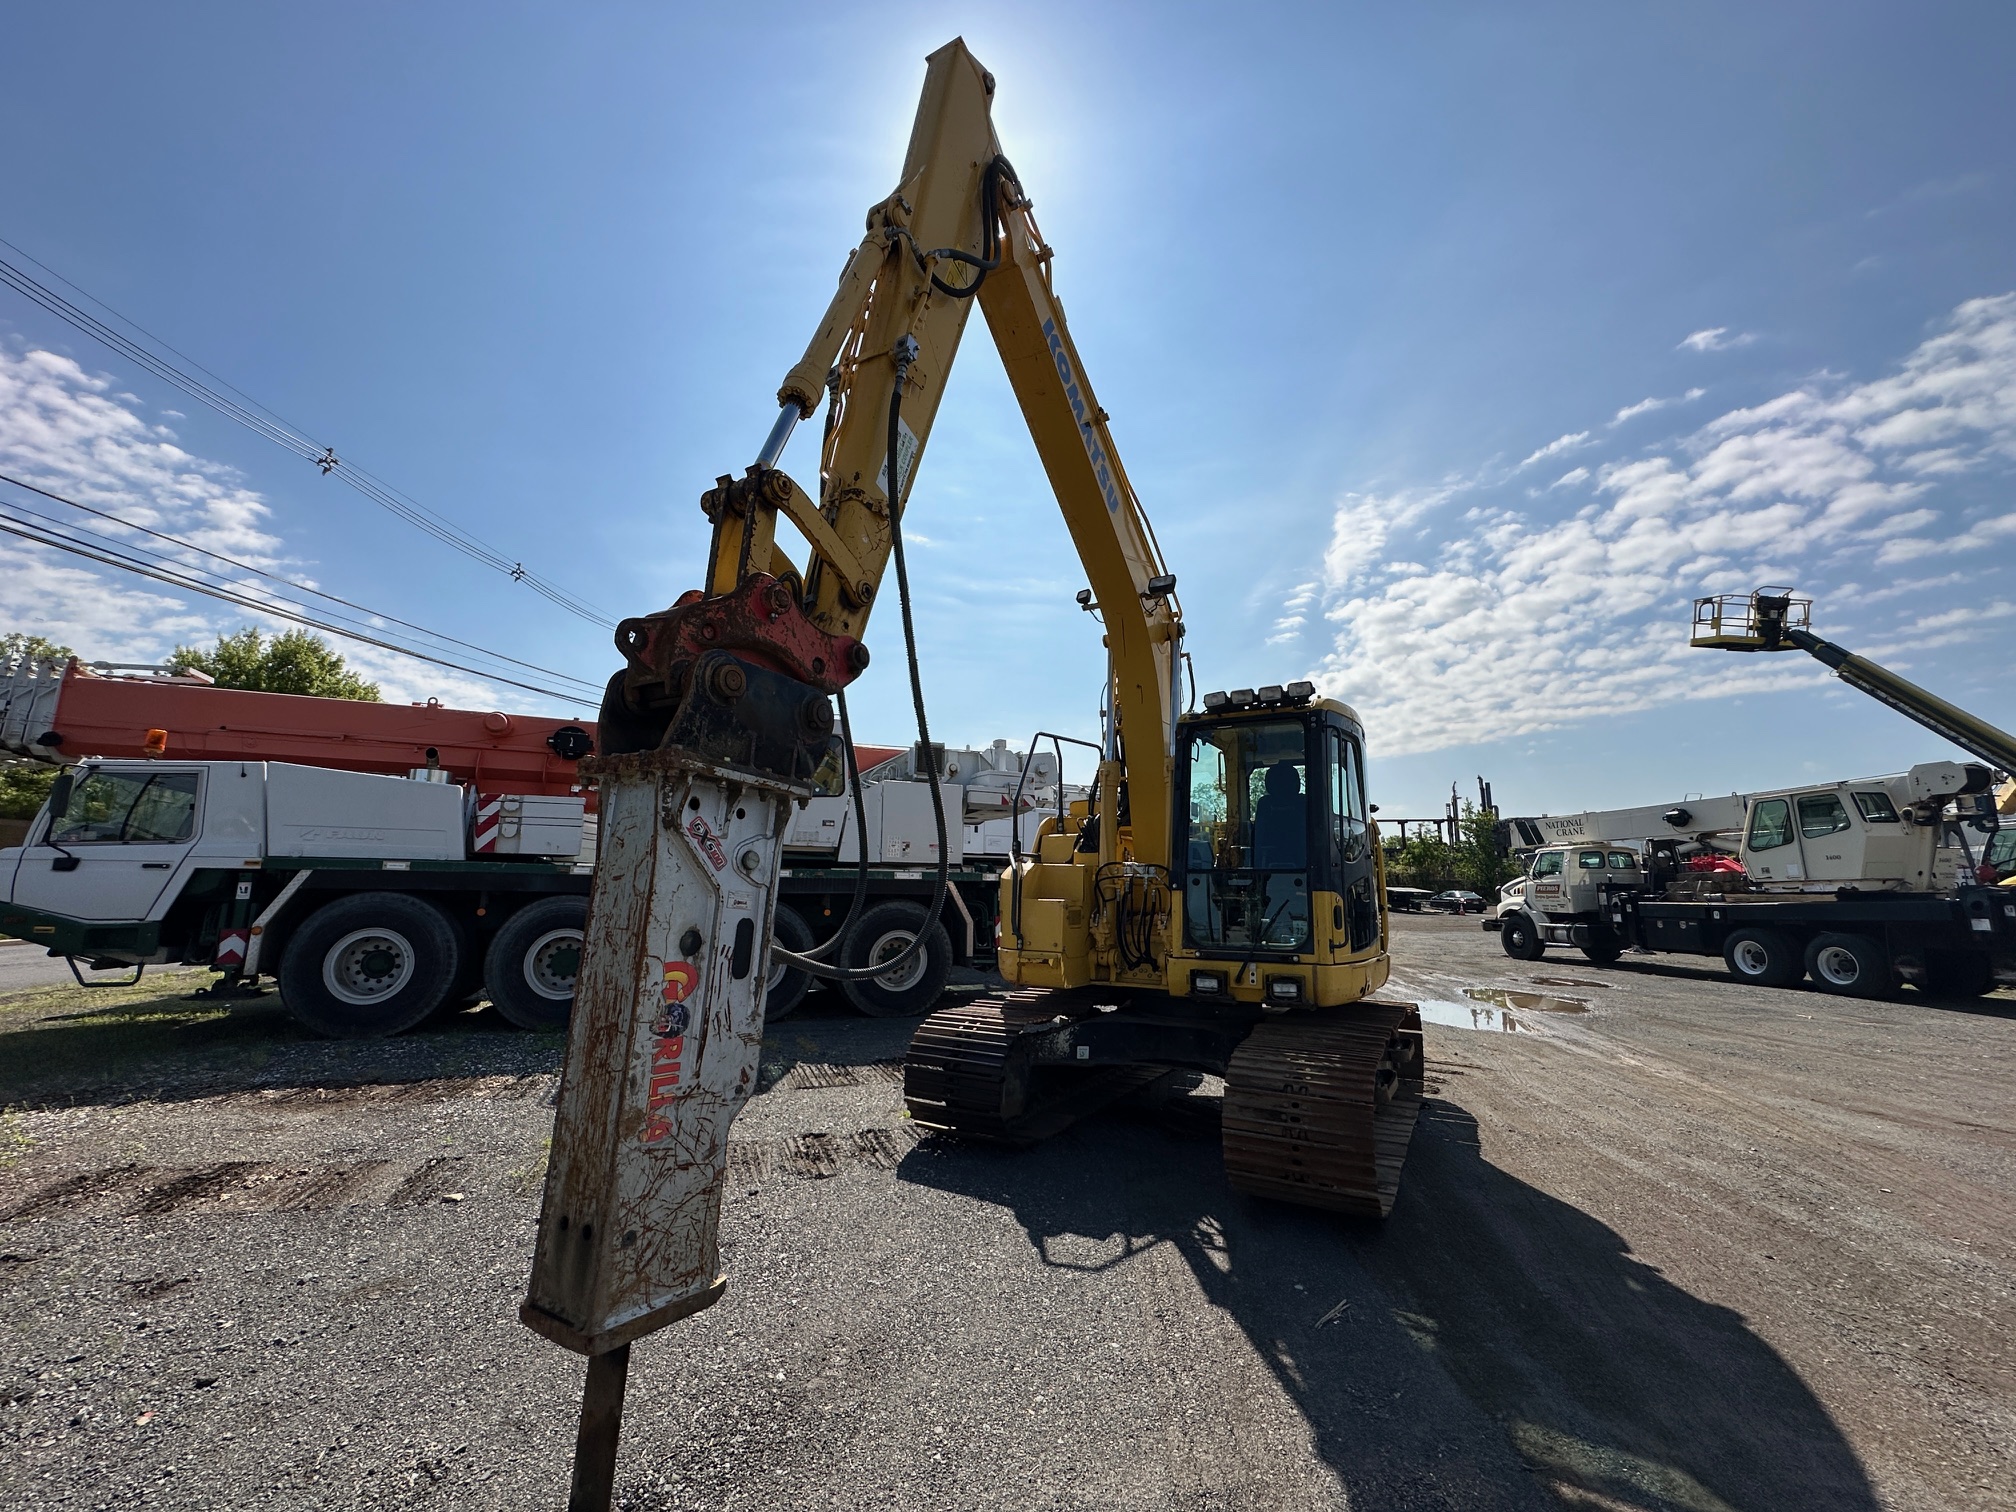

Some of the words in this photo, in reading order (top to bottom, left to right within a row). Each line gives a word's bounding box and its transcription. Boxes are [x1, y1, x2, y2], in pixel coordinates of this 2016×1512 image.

[1043, 317, 1119, 514] KOMATSU
[1545, 819, 1584, 830] NATIONAL
[1556, 827, 1585, 837] CRANE
